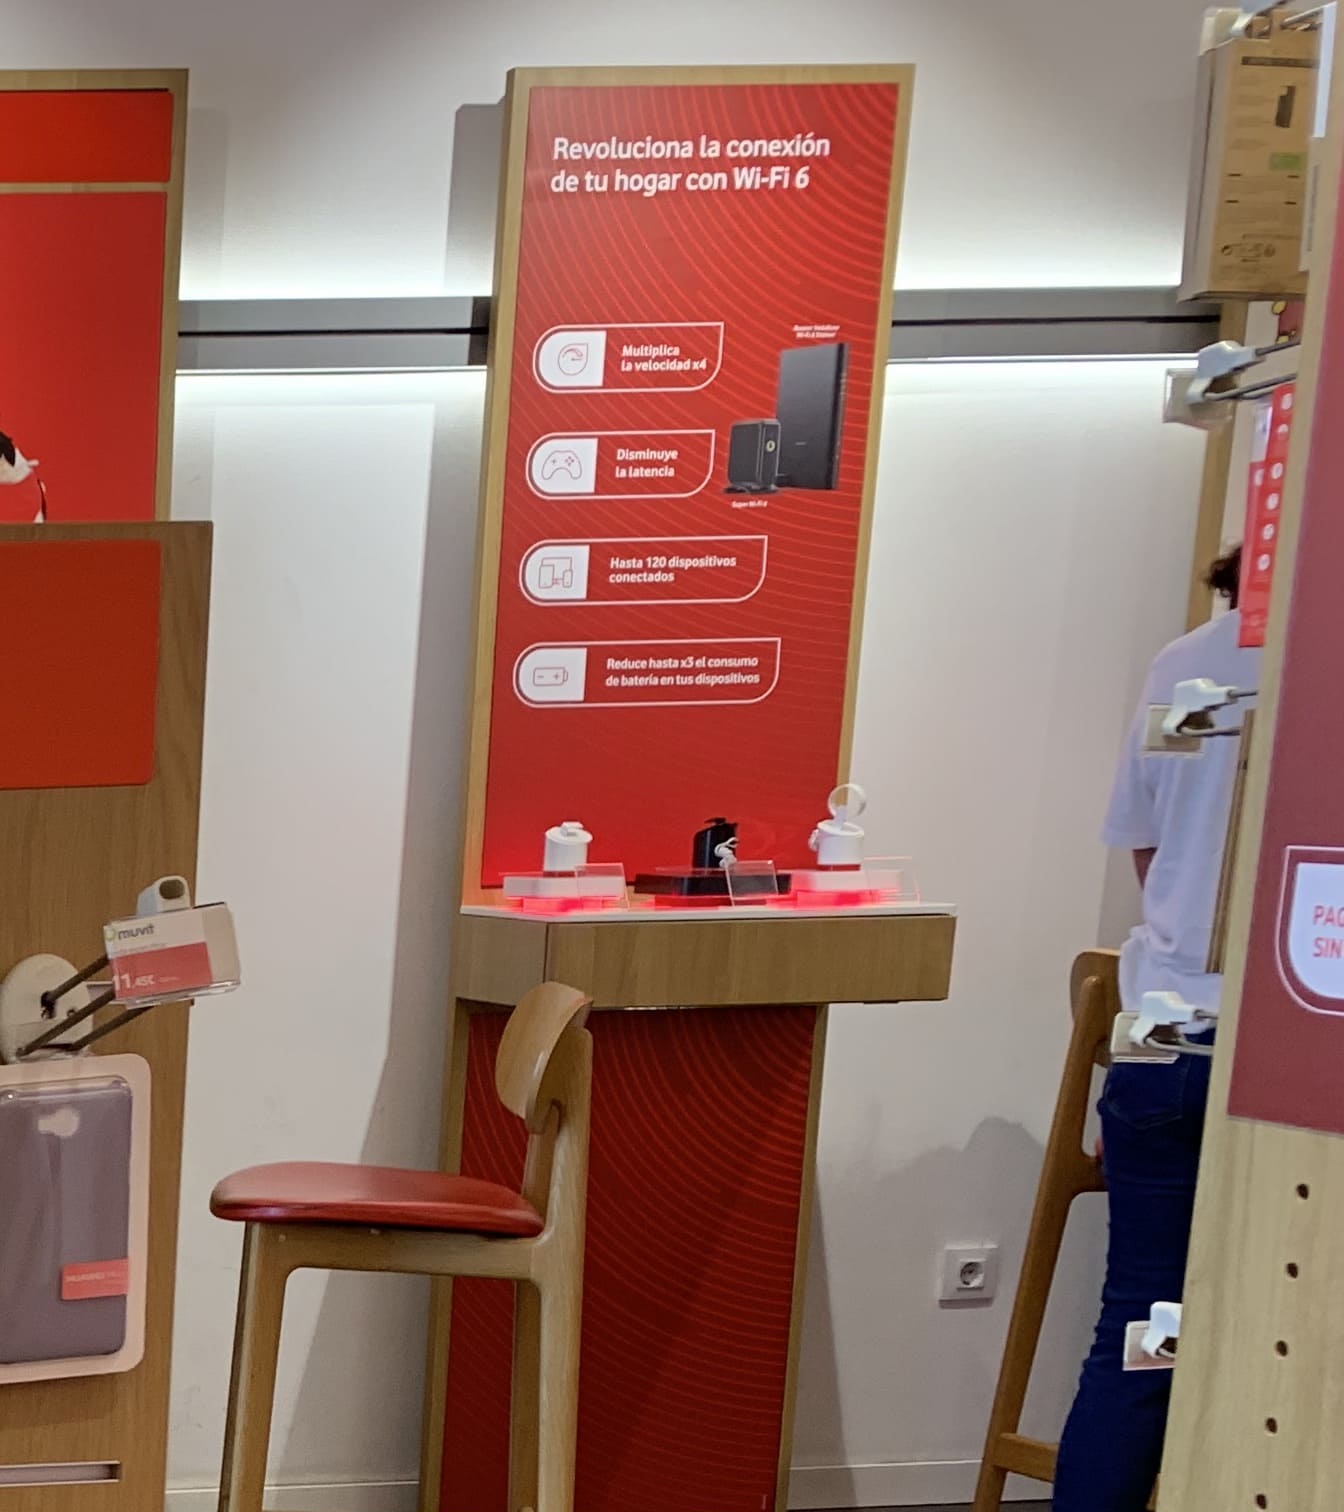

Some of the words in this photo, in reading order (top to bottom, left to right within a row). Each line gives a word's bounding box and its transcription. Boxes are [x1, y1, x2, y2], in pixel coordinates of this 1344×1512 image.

[553, 135, 693, 159] Revoluciona
[700, 134, 720, 157] la
[726, 132, 830, 156] conexión
[550, 169, 579, 192] de
[584, 172, 609, 191] tu
[614, 170, 681, 197] hogar
[685, 171, 728, 190] con
[732, 167, 790, 190] Wi-Fi
[794, 167, 810, 189] 6
[622, 345, 680, 359] Multiplica
[621, 360, 632, 371] la
[635, 359, 690, 370] velocidad
[692, 359, 707, 370] x4
[616, 448, 678, 462] Disminuye
[615, 466, 626, 478] la
[629, 466, 674, 477] latencia
[610, 557, 643, 569] Hasta
[646, 557, 667, 568] 120
[669, 555, 737, 570] dispositivos
[609, 571, 675, 583] conectados
[607, 658, 647, 670] Reduce
[649, 657, 678, 670] hasta
[680, 657, 694, 669] x3
[696, 657, 707, 668] el
[708, 656, 759, 668] consumo
[605, 674, 618, 687] de
[619, 673, 660, 686] batería
[660, 675, 674, 685] en
[676, 674, 693, 685] tus
[696, 672, 760, 687] dispositivos
[118, 924, 154, 940] muvit
